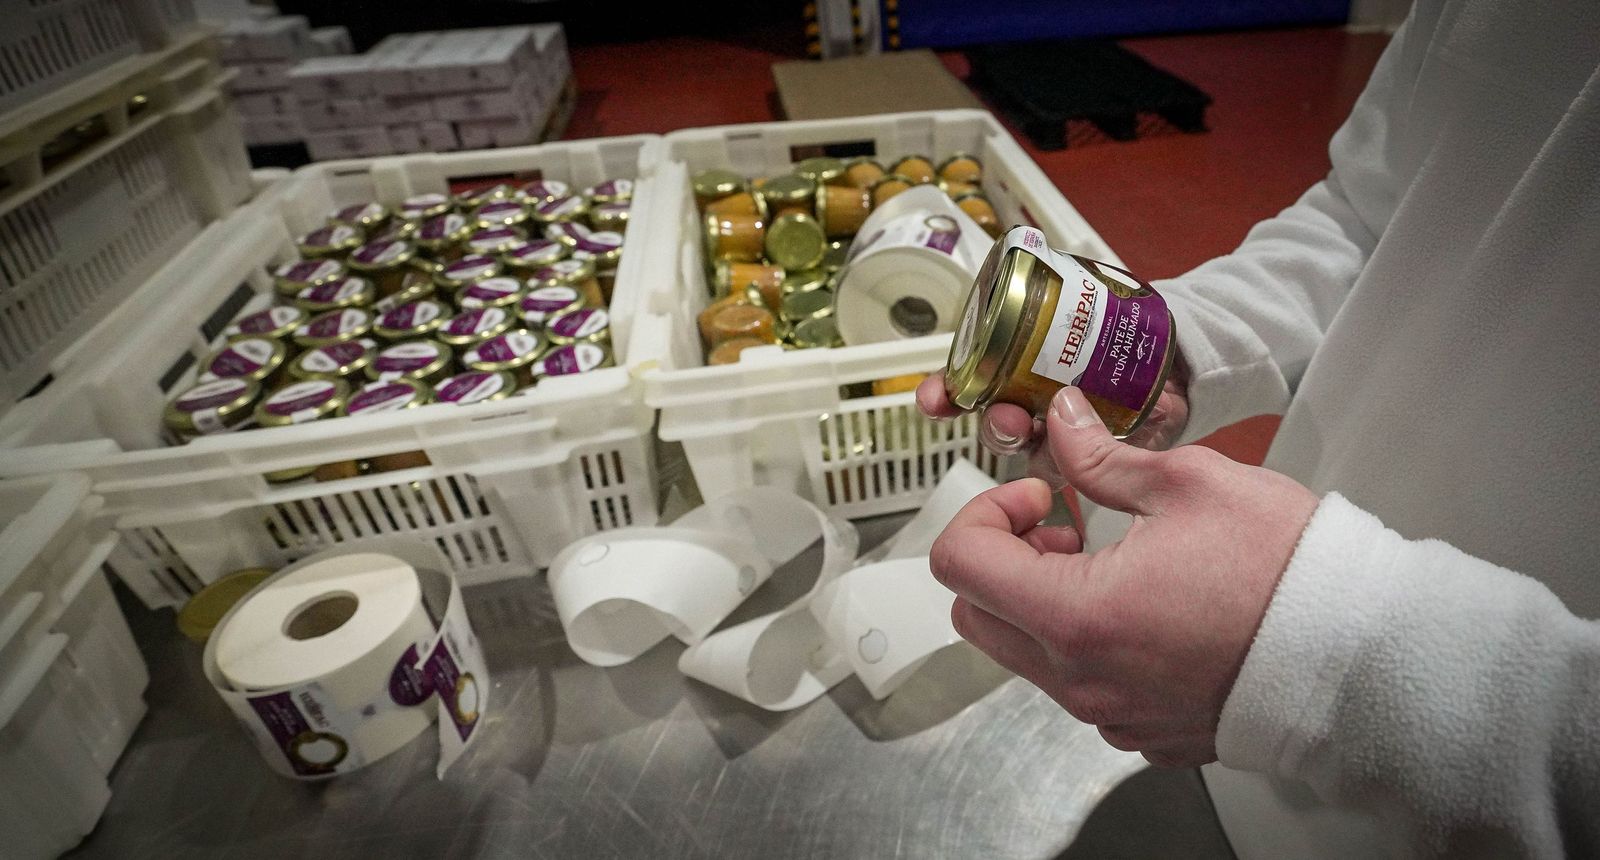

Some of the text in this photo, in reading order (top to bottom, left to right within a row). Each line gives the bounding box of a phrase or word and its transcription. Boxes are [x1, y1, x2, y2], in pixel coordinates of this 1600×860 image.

[1058, 279, 1096, 367] HERPAC
[1101, 316, 1113, 347] ARTESANAL
[1110, 315, 1128, 358] PATÉ DE
[1110, 302, 1140, 385] ATÚN AHUMADO
